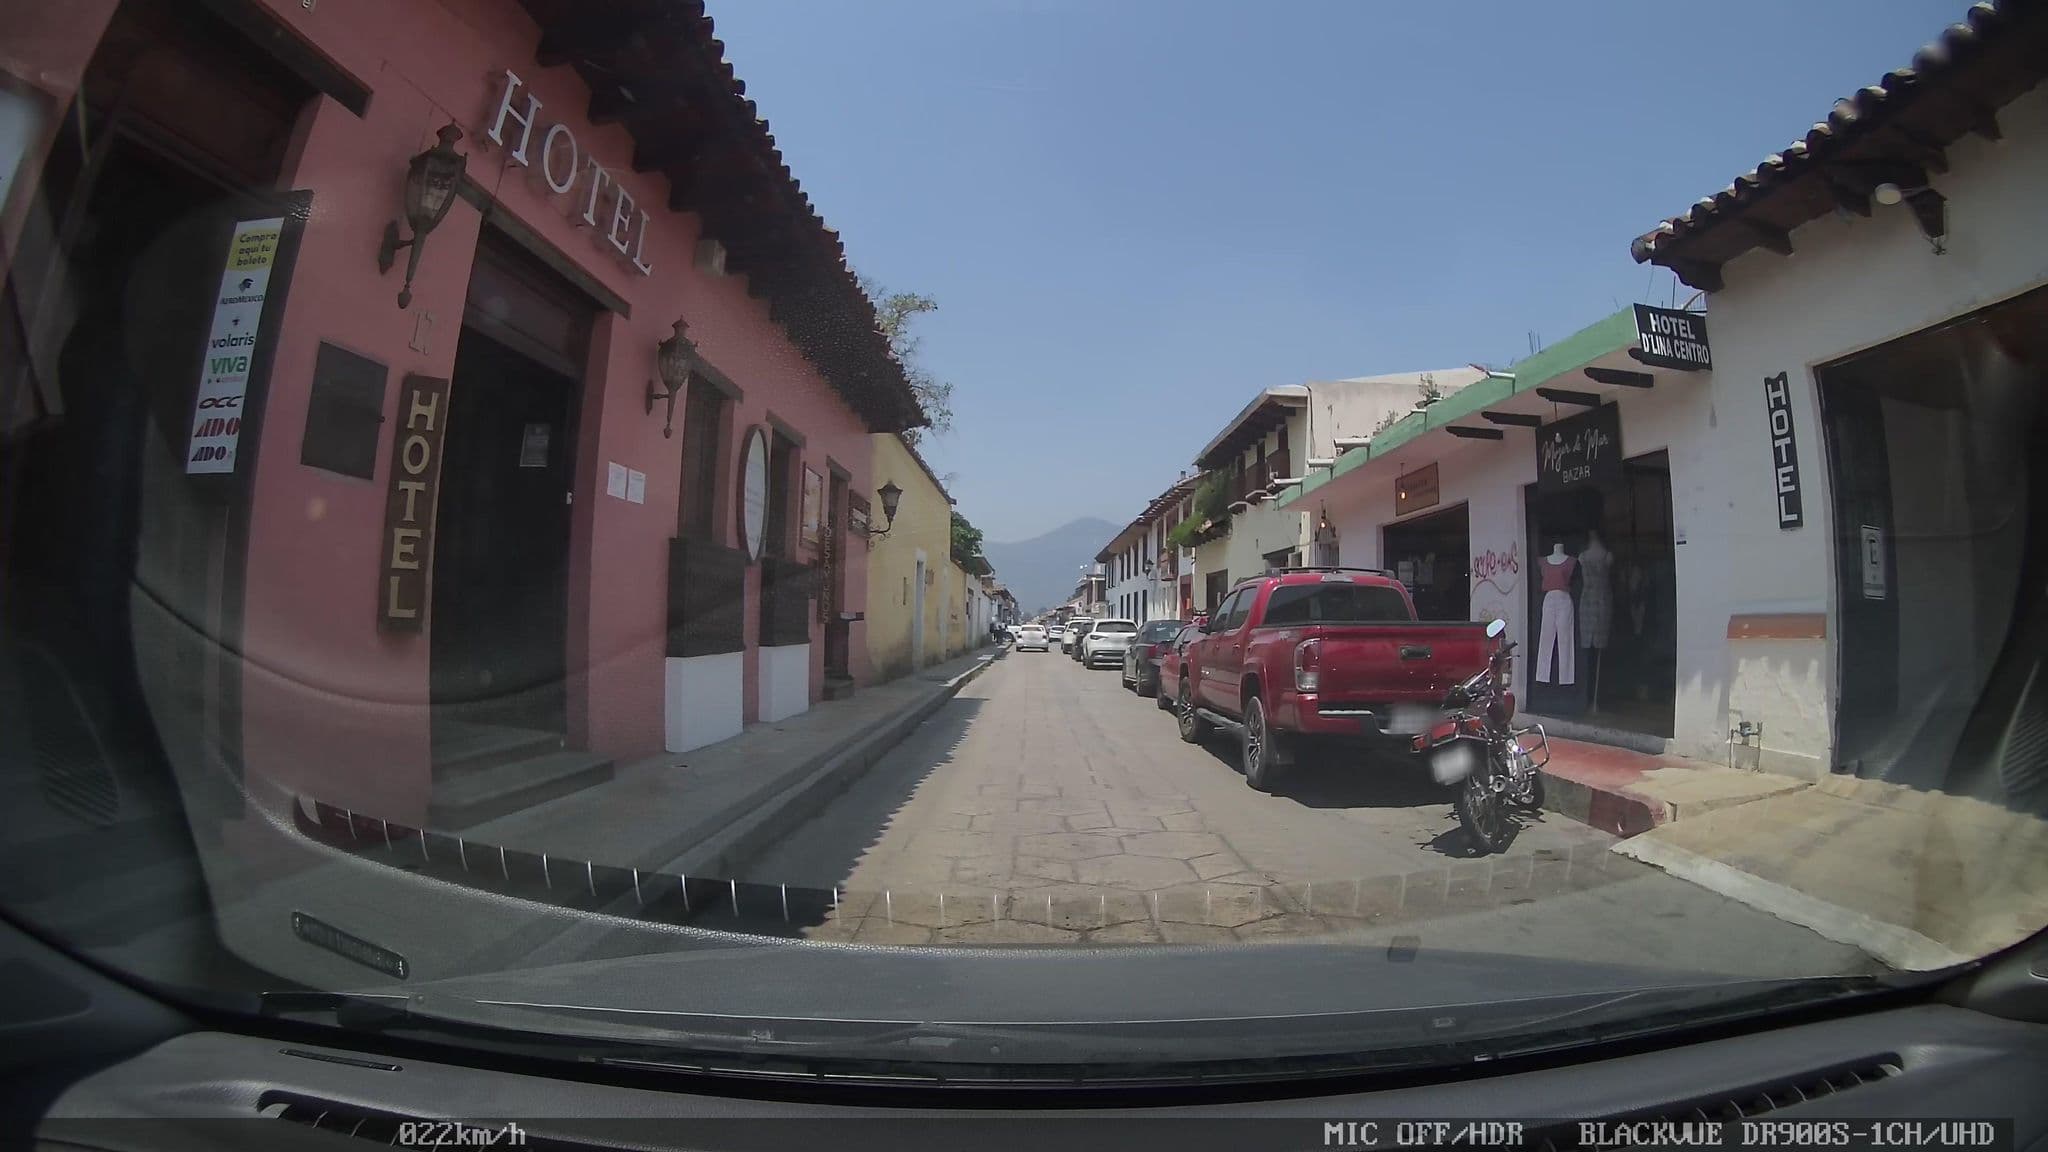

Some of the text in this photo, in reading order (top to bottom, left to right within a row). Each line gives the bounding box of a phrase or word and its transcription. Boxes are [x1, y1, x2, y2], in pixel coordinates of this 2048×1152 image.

[487, 68, 653, 276] HOTEL
[240, 231, 278, 244] Compra
[262, 244, 271, 253] tu
[236, 256, 268, 266] boleto
[1650, 312, 1696, 340] HOTEL
[212, 332, 255, 348] volaris
[1674, 338, 1710, 364] CENTRO
[194, 417, 241, 438] ADO
[191, 446, 227, 462] ADO
[1767, 380, 1798, 522] HOTEL
[1562, 465, 1591, 483] BAZAR
[388, 390, 440, 618] HOTEL
